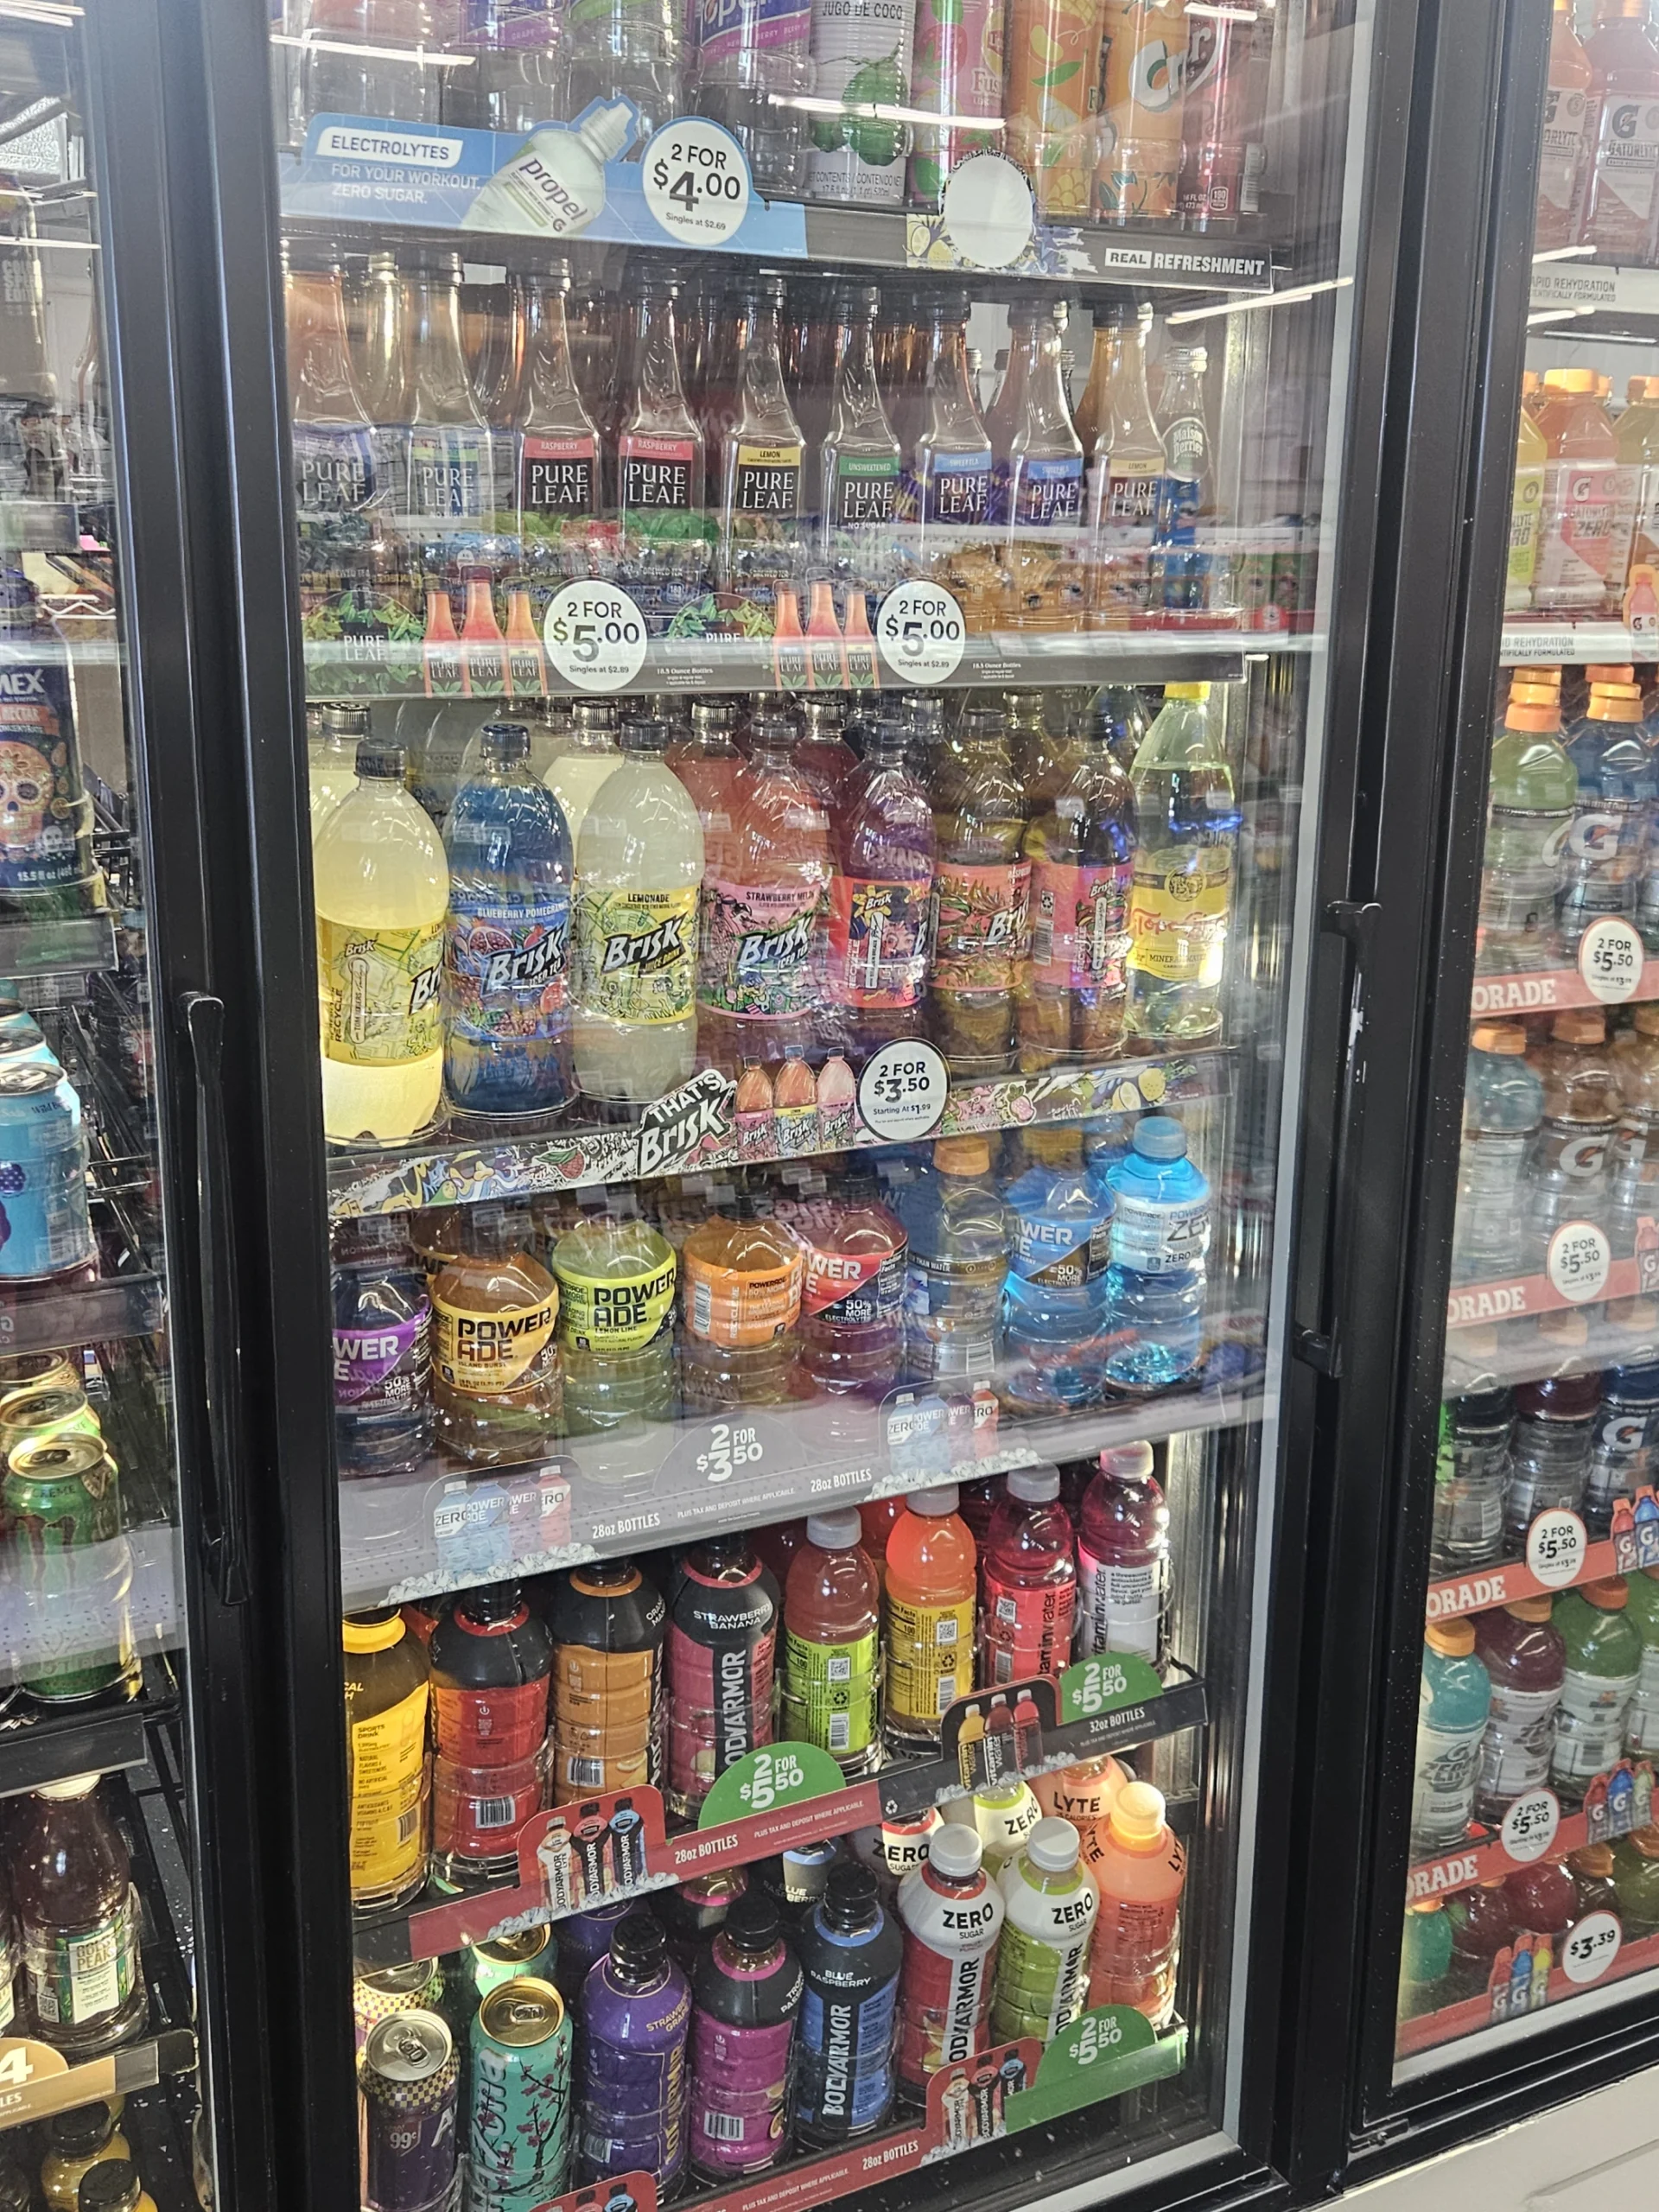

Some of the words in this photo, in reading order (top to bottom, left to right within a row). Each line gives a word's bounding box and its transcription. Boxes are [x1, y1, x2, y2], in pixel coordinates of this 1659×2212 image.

[823, 1, 850, 17] JUGO
[874, 3, 903, 20] COCO
[331, 135, 449, 161] ELECTROLYTES
[671, 143, 682, 162] 2
[688, 145, 727, 170] FOR
[332, 163, 360, 178] FOR
[365, 165, 404, 182] YOUR
[409, 170, 481, 191] WORKOUT.
[653, 158, 741, 212] $4.00
[332, 184, 371, 200] ZERO
[375, 187, 428, 204] SUGAR.
[519, 157, 588, 223] propel
[666, 213, 693, 225] Singles
[704, 219, 726, 230] $2.69
[1110, 251, 1147, 265] REAL
[1154, 252, 1265, 276] REFRESHMENT
[1555, 278, 1616, 293] REHYDRATION
[541, 441, 578, 451] RASPBERRY
[638, 441, 677, 451] RASPBERRY
[760, 450, 781, 459] LEMON
[302, 461, 365, 482] PURE
[423, 466, 473, 486] PURE
[531, 464, 588, 484] PURE
[629, 463, 686, 485] PURE
[848, 461, 891, 472] UNSWEETENED
[744, 472, 793, 491] PURE
[845, 481, 894, 501] PURE
[940, 476, 988, 496] PURE
[1032, 484, 1077, 501] PURE
[1113, 481, 1158, 499] PURE
[302, 483, 365, 503] LEAF
[424, 487, 471, 507] LEAF
[567, 601, 578, 617] 2
[583, 601, 622, 619] FOR
[899, 601, 908, 614] 2
[913, 601, 946, 617] FOR
[344, 635, 385, 647] PURE
[553, 617, 639, 662] $5.00
[886, 614, 959, 657] $5.00
[1514, 637, 1574, 648] REHYDRATION
[569, 664, 597, 675] Singles
[608, 665, 629, 674] $2.89
[898, 658, 921, 669] Singles
[931, 660, 950, 669] $2.89
[1569, 813, 1624, 861] G
[627, 893, 670, 903] LEMONADE
[746, 891, 795, 902] STRAWBERRY
[865, 893, 892, 910] Brisk
[478, 907, 524, 919] BLUEBERRY
[346, 939, 375, 957] Brisk
[605, 918, 683, 971] Brisk
[739, 916, 811, 968] Brisk
[1598, 938, 1605, 949] 2
[1608, 939, 1631, 952] FOR
[487, 929, 564, 991] Brisk
[1593, 950, 1633, 972] $5.50
[1471, 979, 1557, 1012] ORADE
[880, 1065, 888, 1077] 2
[893, 1062, 925, 1076] FOR
[649, 1072, 721, 1123] THAT'S
[874, 1077, 930, 1104] $3.50
[873, 1106, 899, 1116] Starting
[901, 1105, 909, 1114] At
[911, 1103, 931, 1115] $1.99
[783, 1121, 809, 1146] Brisk
[823, 1113, 849, 1134] Brisk
[640, 1096, 724, 1174] Brisk
[742, 1123, 766, 1147] Brisk
[1125, 1207, 1161, 1219] POWERADE
[1562, 1243, 1569, 1254] 2
[1571, 1237, 1596, 1253] FOR
[808, 1253, 861, 1281] WER
[915, 1256, 930, 1269] THAN
[931, 1260, 950, 1273] WATER
[1166, 1252, 1191, 1263] ZERO
[1560, 1249, 1600, 1274] $5.50
[1058, 1265, 1082, 1276] 50%
[1058, 1274, 1081, 1283] MORE
[594, 1268, 675, 1306] POWER
[749, 1276, 787, 1289] POWERADE
[594, 1303, 648, 1327] ADE
[846, 1299, 872, 1310] 50%
[846, 1308, 872, 1318] MORE
[458, 1307, 551, 1338] POWER
[334, 1336, 399, 1360] WER
[458, 1339, 513, 1363] ADE
[385, 1383, 411, 1398] MORE
[711, 1424, 730, 1452] 2
[734, 1427, 755, 1446] FOR
[810, 1478, 832, 1493] 28oz
[833, 1468, 873, 1489] BOTTLES
[677, 1509, 692, 1519] PLUS
[693, 1506, 703, 1516] TAX
[705, 1503, 717, 1514] AND
[718, 1498, 741, 1510] DEPOSIT
[741, 1493, 761, 1506] WHERE
[592, 1524, 616, 1539] 28oz
[618, 1513, 661, 1535] BOTTLES
[1541, 1528, 1548, 1539] 2
[1551, 1526, 1573, 1538] FOR
[1538, 1537, 1577, 1559] $5.50
[1427, 1575, 1507, 1618] ORADE
[694, 1603, 772, 1624] STRAWBERRY
[710, 1616, 761, 1630] BANANA
[1084, 1662, 1101, 1685] 2
[1103, 1664, 1122, 1681] FOR
[724, 1649, 746, 1768] ODYARMOR
[358, 1724, 385, 1732] SPORTS
[1090, 1719, 1109, 1733] 32oz
[1109, 1707, 1145, 1726] BOTTLES
[753, 1753, 772, 1780] 2
[775, 1755, 797, 1771] FOR
[1054, 1791, 1100, 1813] LYTE
[1517, 1806, 1522, 1816] 2
[1526, 1801, 1548, 1815] FOR
[754, 1829, 767, 1839] PLUS
[768, 1826, 779, 1835] TAX
[779, 1822, 791, 1832] AND
[792, 1815, 813, 1827] DEPOSIT
[815, 1809, 832, 1821] WHERE
[1004, 1796, 1039, 1835] ZERO
[1512, 1812, 1549, 1834] $5.50
[621, 1834, 633, 1887] ODYARMOR
[675, 1849, 697, 1865] 28oz
[698, 1834, 738, 1857] BOTTLES
[873, 1840, 930, 1864] ZERO
[587, 1842, 600, 1897] ODYARMOR
[943, 1902, 994, 1931] ZERO
[1052, 1892, 1093, 1925] ZERO
[959, 1928, 984, 1940] SUGAR
[1068, 1918, 1087, 1932] SUGAR
[1570, 1929, 1617, 1960] $3.39
[77, 1948, 112, 1971] PEAK
[810, 1970, 871, 1987] RASPBERRY
[825, 1970, 854, 1980] BLUE
[1053, 1942, 1084, 2037] ODYARMOR
[949, 1958, 979, 2063] ODYARMOR
[1082, 2018, 1096, 2038] 2
[1098, 2016, 1117, 2031] FOR
[822, 2004, 852, 2116] BODYARMOR
[862, 2152, 882, 2171] 28oz
[883, 2140, 918, 2163] BOTTLES
[743, 2200, 756, 2211] PLUS
[757, 2196, 766, 2207] TAX
[767, 2193, 779, 2202] AND
[779, 2185, 800, 2198] DEPOSIT
[801, 2178, 818, 2191] WHERE
